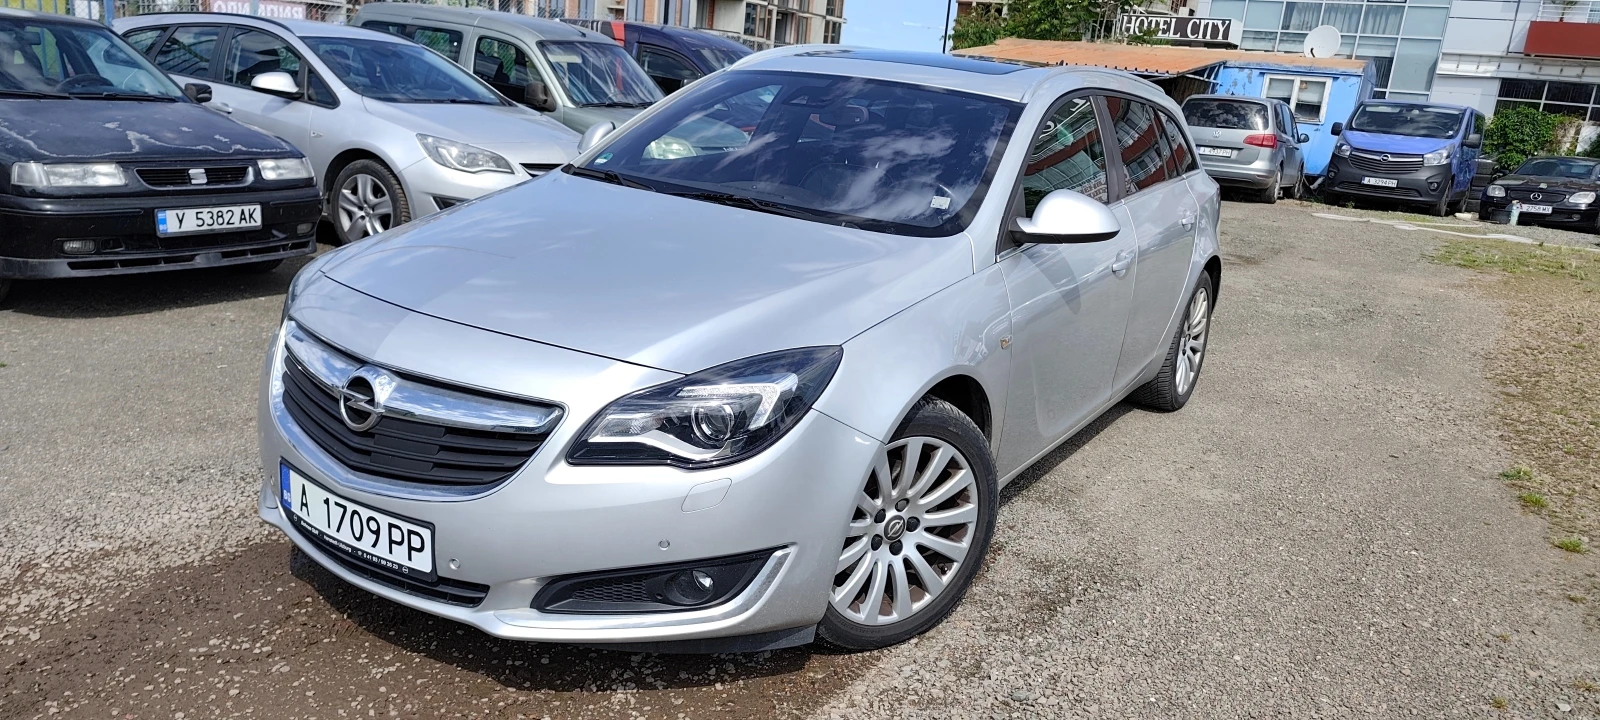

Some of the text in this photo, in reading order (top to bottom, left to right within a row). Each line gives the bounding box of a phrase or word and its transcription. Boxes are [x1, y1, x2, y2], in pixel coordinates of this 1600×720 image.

[1122, 15, 1229, 40] HOTEL CITY
[195, 209, 235, 228] 5382
[239, 207, 258, 225] AK
[300, 483, 310, 517] A
[323, 497, 381, 549] 1709
[387, 522, 426, 562] PP
